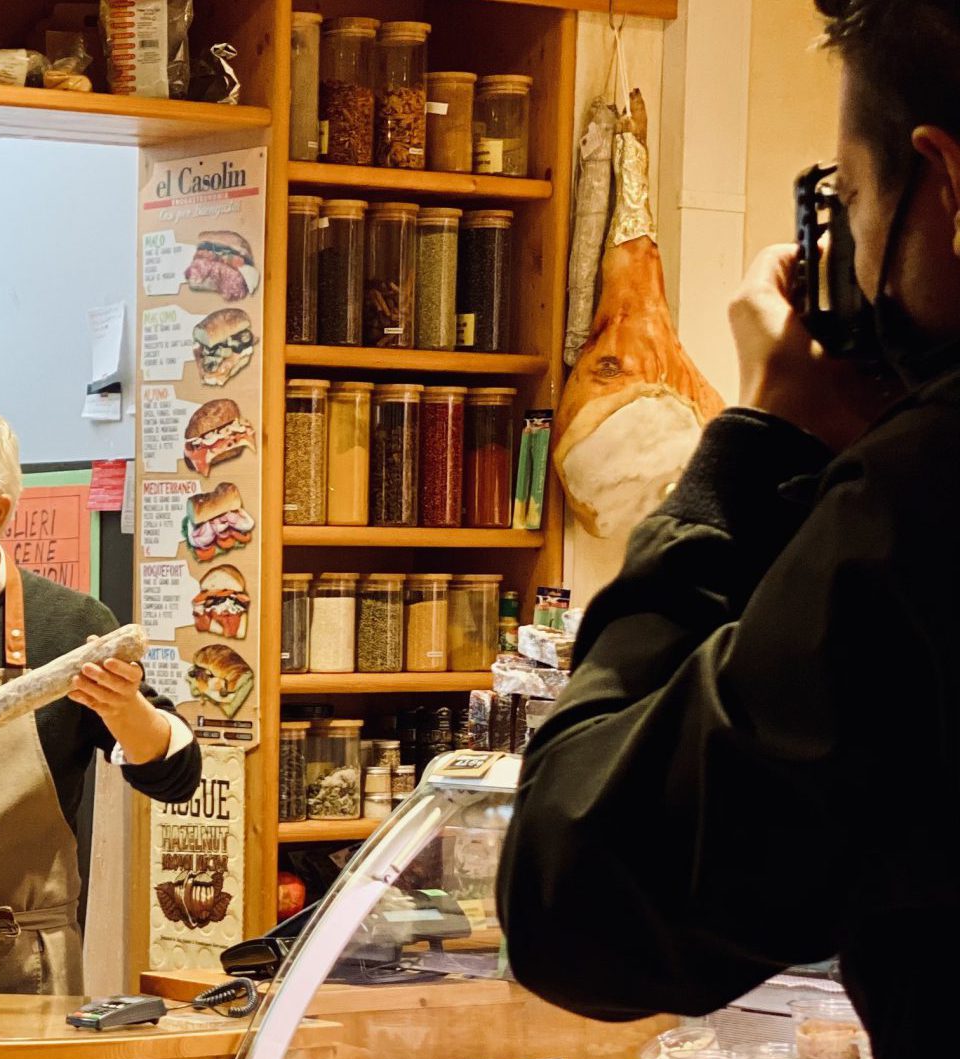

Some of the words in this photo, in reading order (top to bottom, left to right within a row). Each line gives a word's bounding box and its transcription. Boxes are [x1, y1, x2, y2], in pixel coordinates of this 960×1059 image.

[156, 169, 171, 199] el
[178, 161, 246, 195] Casolin
[143, 482, 197, 496] MEDITERRANEO
[13, 540, 57, 565] CENE
[33, 563, 75, 588] ONI
[143, 564, 185, 579] ROQUEFORT
[163, 779, 230, 820] GUE
[161, 823, 230, 853] HAZELNUT
